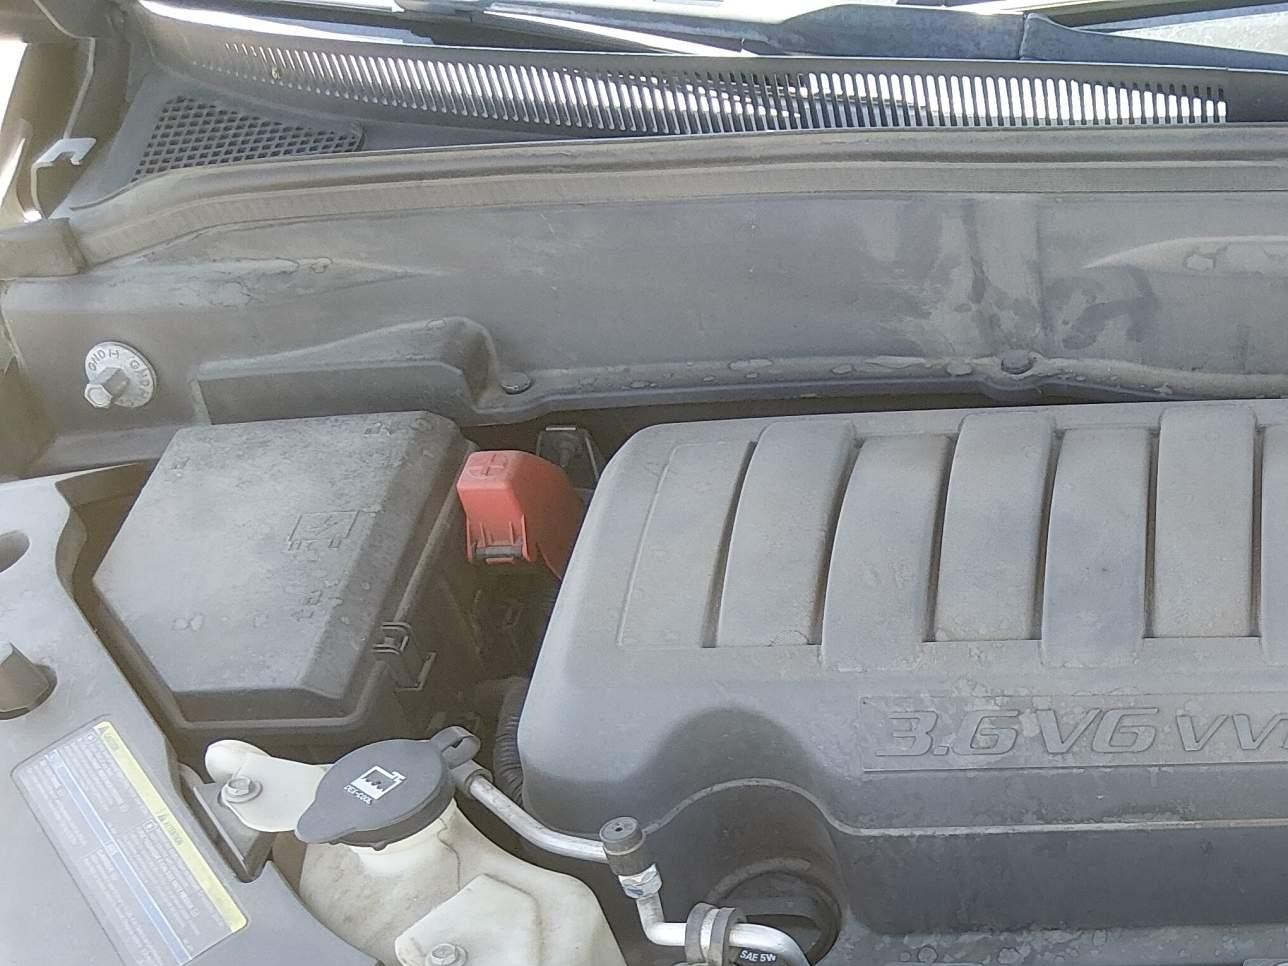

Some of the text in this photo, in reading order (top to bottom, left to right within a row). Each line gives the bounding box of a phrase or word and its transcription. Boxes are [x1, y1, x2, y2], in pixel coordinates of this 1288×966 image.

[875, 710, 1021, 757] 3.6
[1036, 706, 1160, 755] V6
[739, 949, 759, 962] SAE
